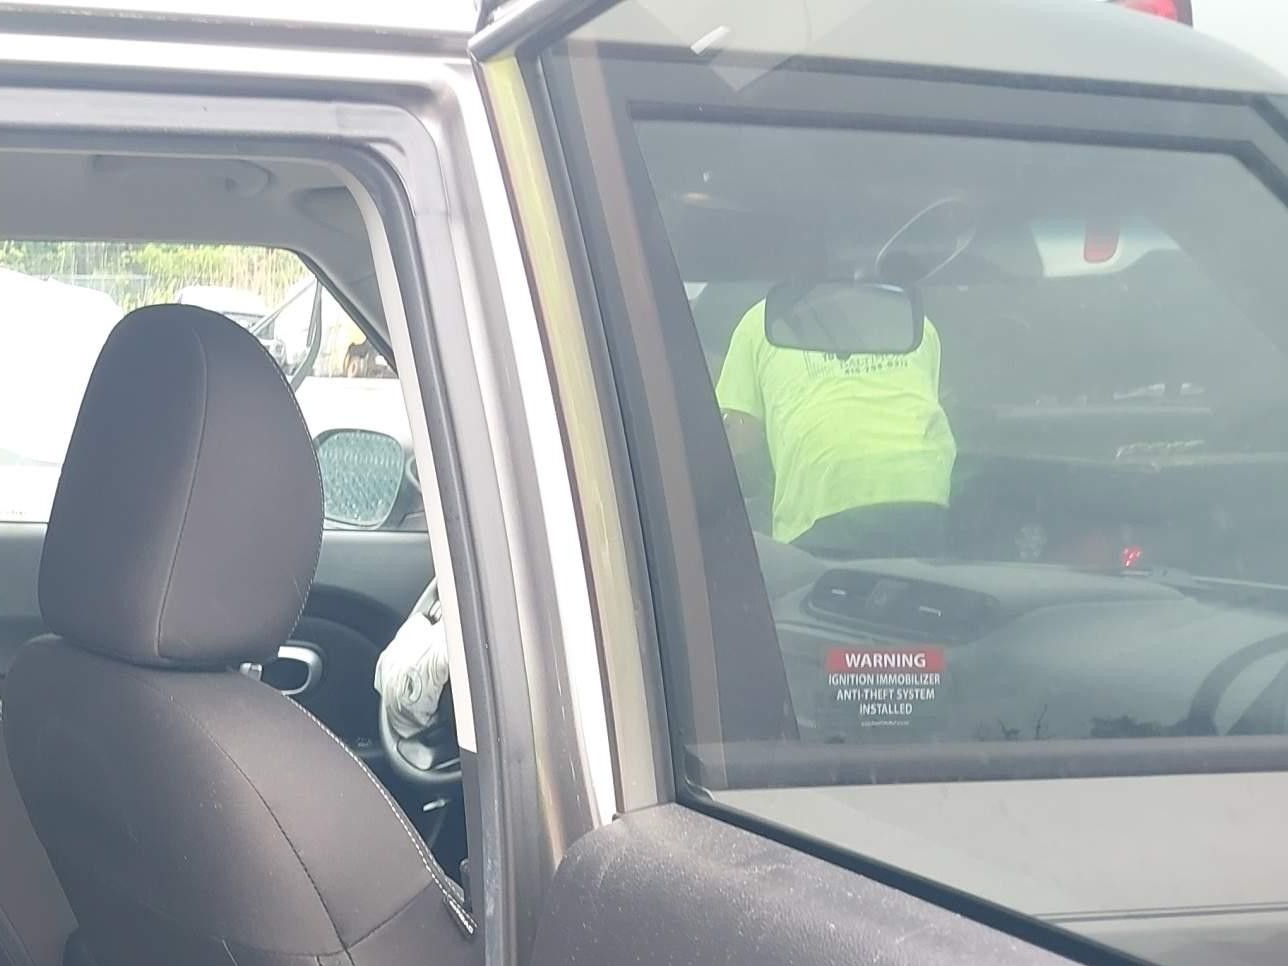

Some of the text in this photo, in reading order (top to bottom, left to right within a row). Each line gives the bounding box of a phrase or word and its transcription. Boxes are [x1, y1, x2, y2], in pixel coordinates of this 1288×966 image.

[845, 652, 927, 669] WARNING
[828, 673, 941, 686] IGNITION IMMOBILIZER
[836, 688, 935, 701] ANTI-THEFT SYSTEM
[859, 703, 913, 716] INSTALLED
